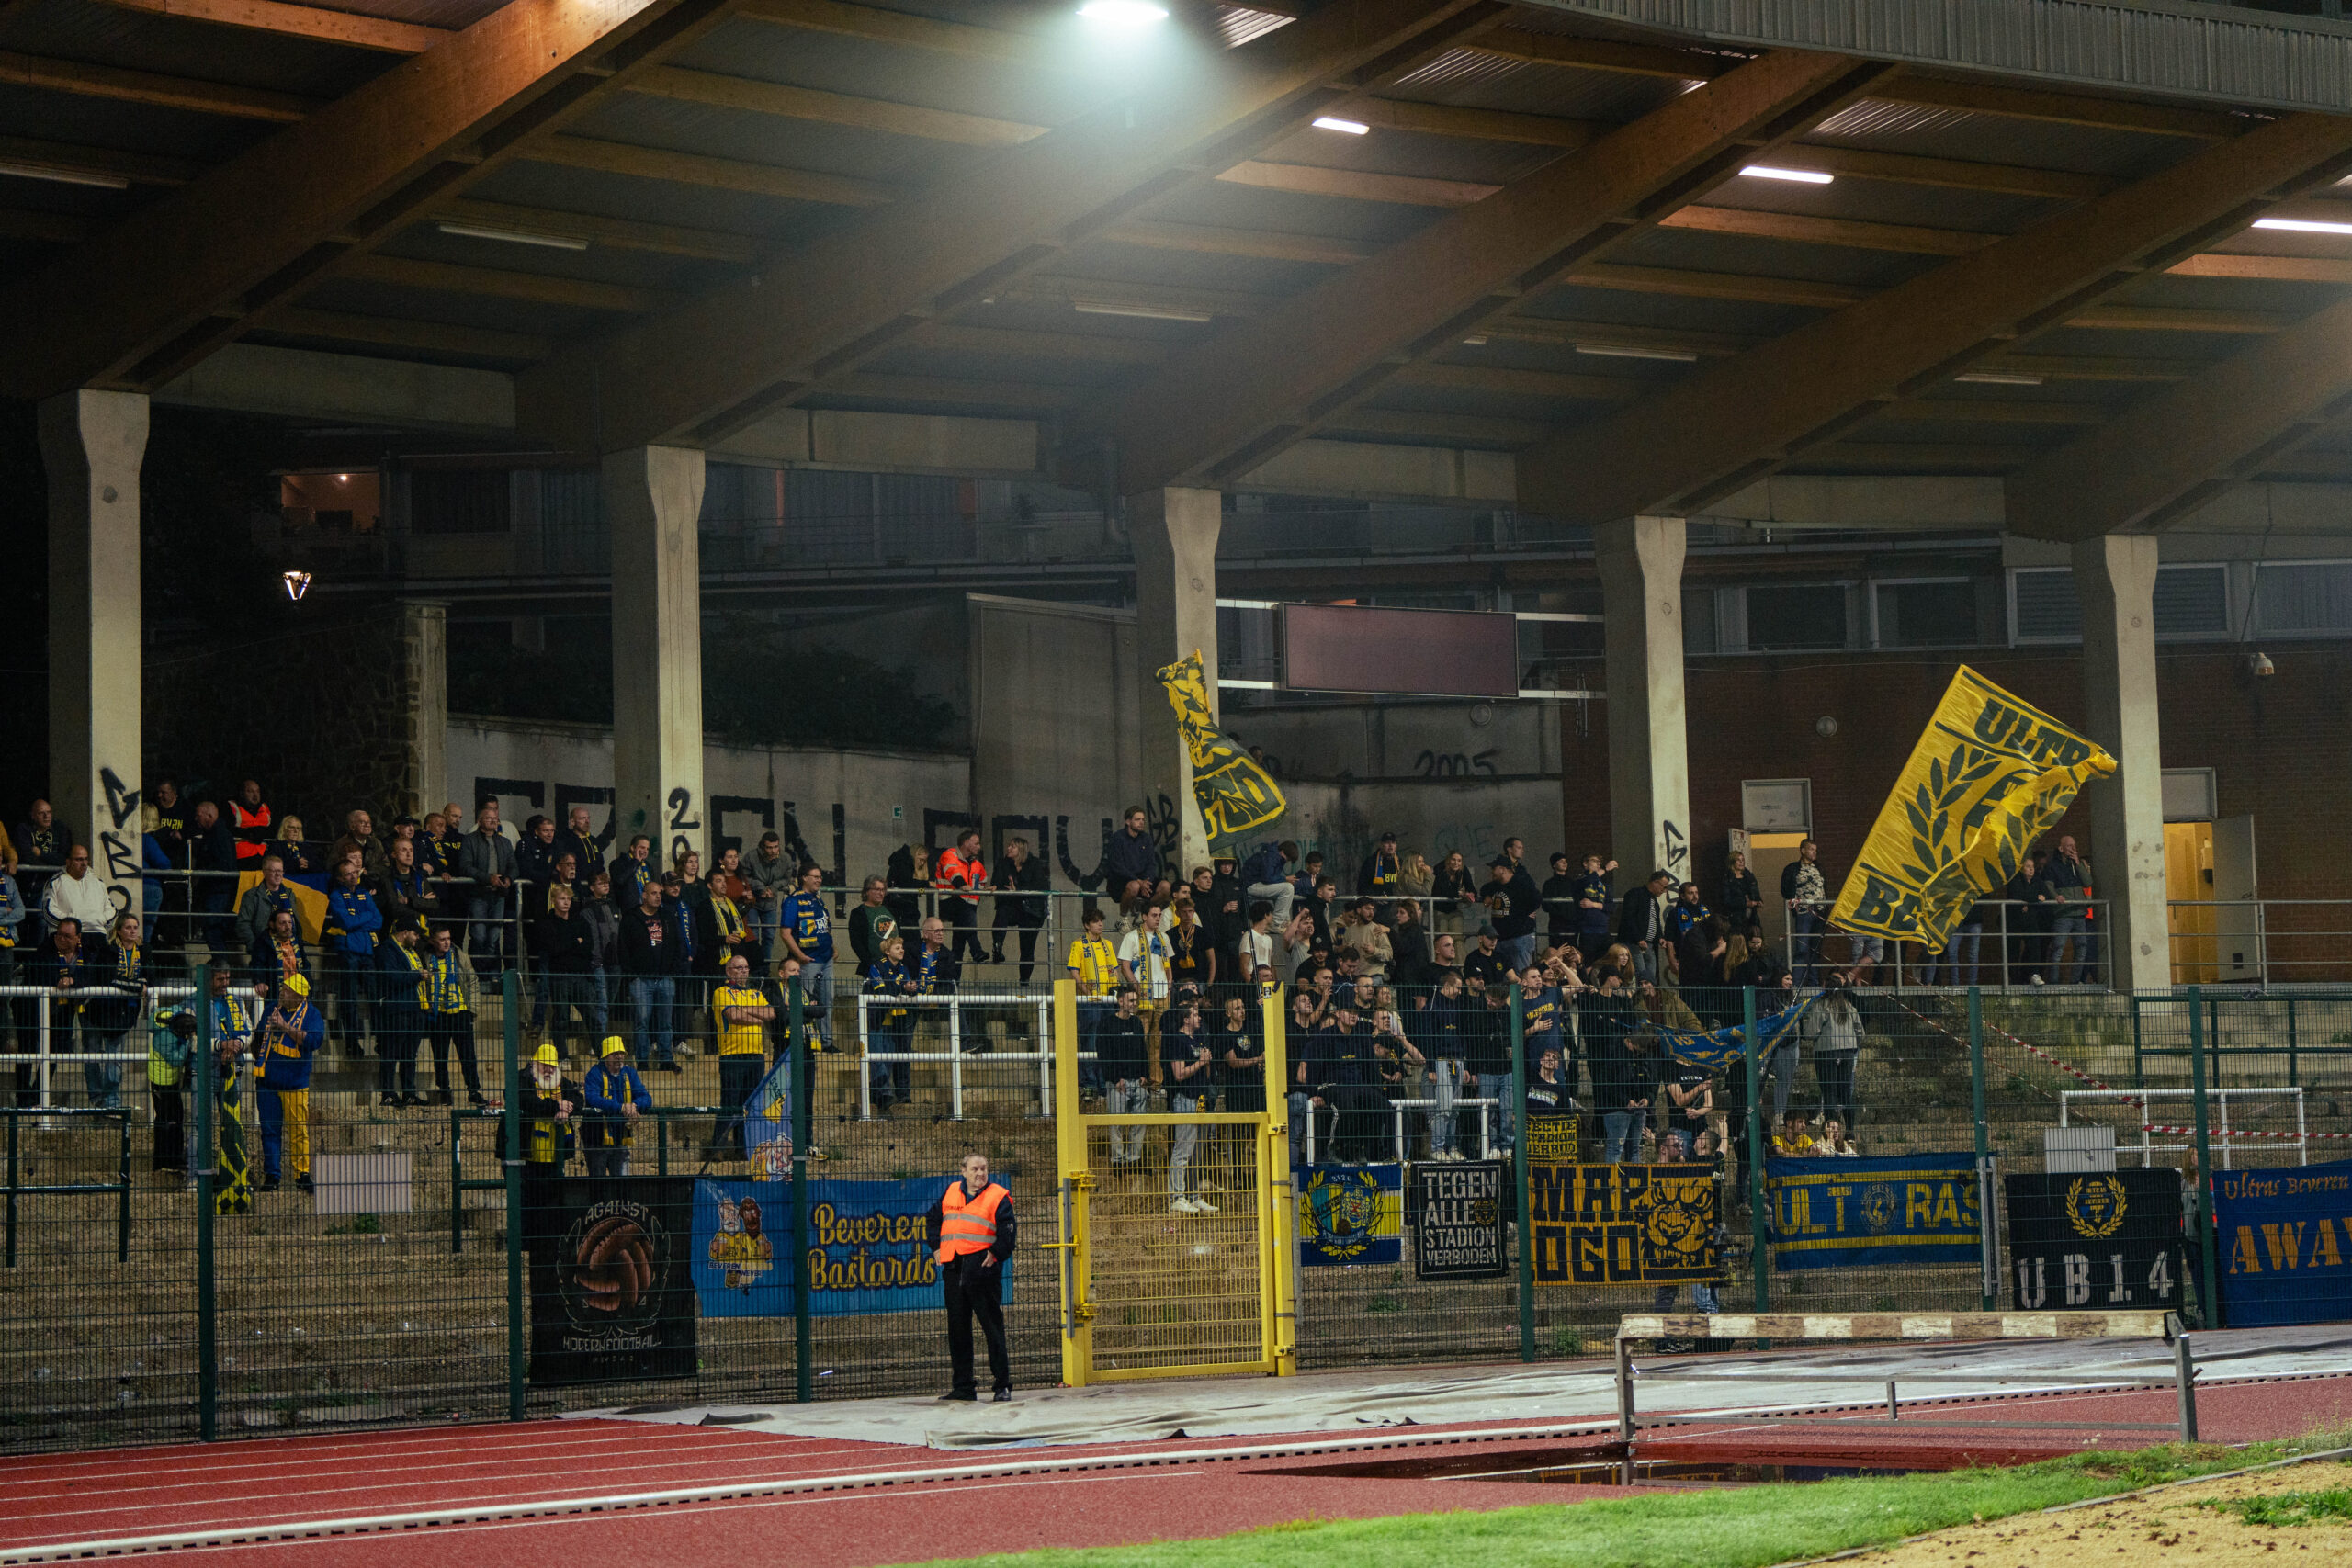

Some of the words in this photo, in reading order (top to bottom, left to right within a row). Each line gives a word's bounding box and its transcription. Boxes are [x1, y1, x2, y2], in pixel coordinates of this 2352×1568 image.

[1422, 1170, 1497, 1199] TEGEN
[2224, 1171, 2281, 1200] Ultras
[2285, 1175, 2350, 1194] Beveren
[585, 1200, 649, 1224] AGAINST
[812, 1202, 928, 1246] Beveren
[1424, 1200, 1476, 1227] ALLE
[1426, 1226, 1496, 1249] STADION
[808, 1242, 936, 1290] Bastards
[1426, 1247, 1497, 1267] VERBODEN
